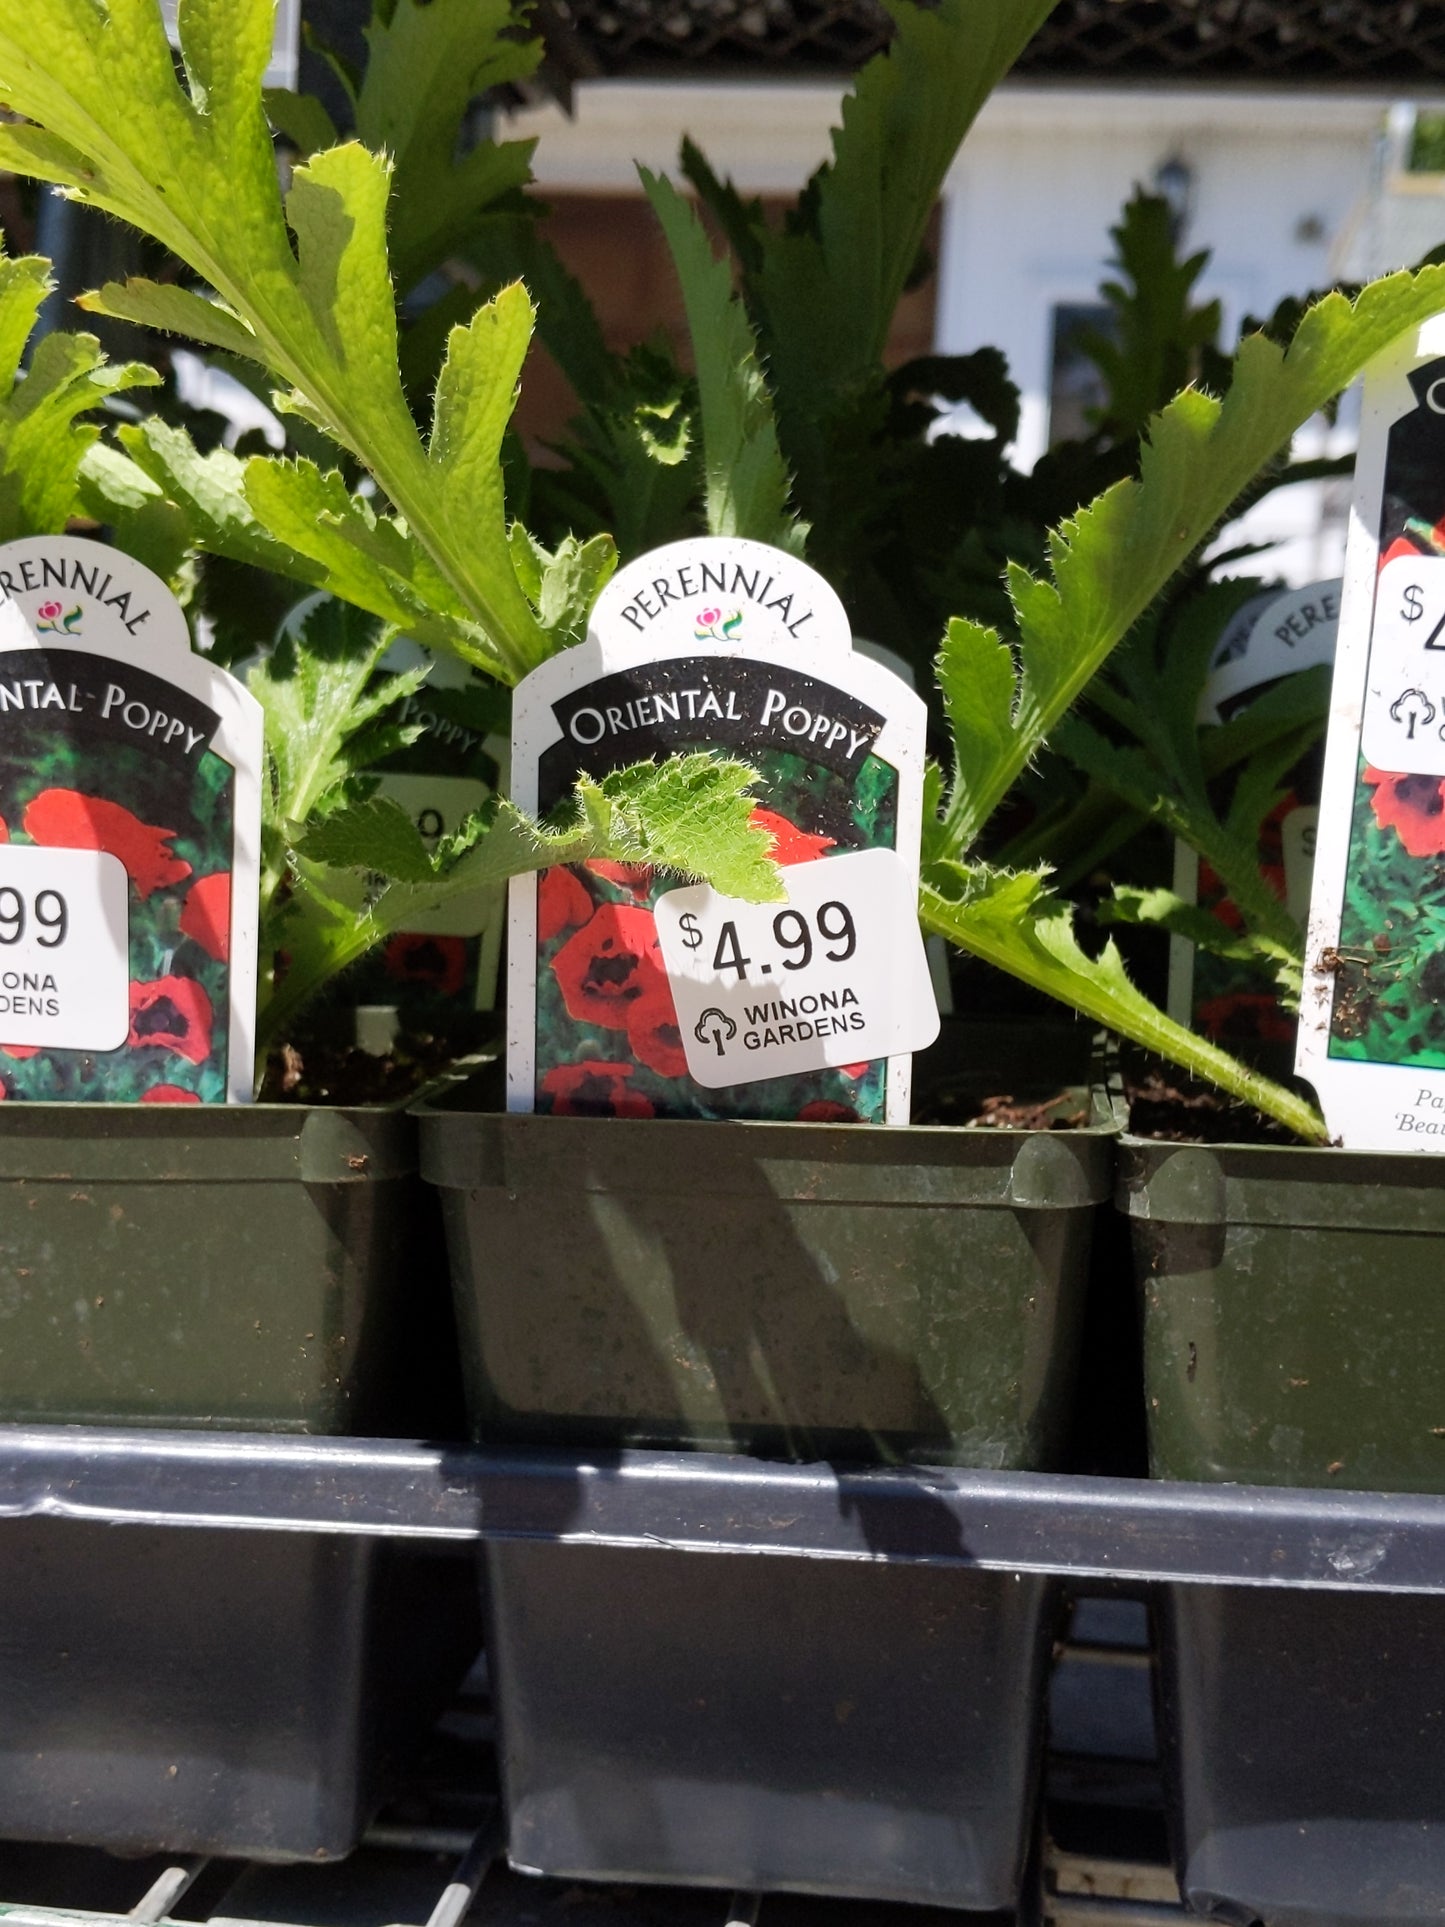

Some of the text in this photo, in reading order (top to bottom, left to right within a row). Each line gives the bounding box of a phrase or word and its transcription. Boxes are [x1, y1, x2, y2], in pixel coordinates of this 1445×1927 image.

[620, 562, 814, 639] PERENNIAL
[101, 683, 205, 755] POPPY
[399, 697, 478, 754] POPPY
[570, 688, 869, 760] ORIENTAL POPPY
[678, 900, 857, 981] $4.99
[2, 972, 58, 993] ONA
[744, 988, 860, 1025] WINONA
[743, 1011, 866, 1050] GARDENS
[1414, 1088, 1445, 1114] Pa
